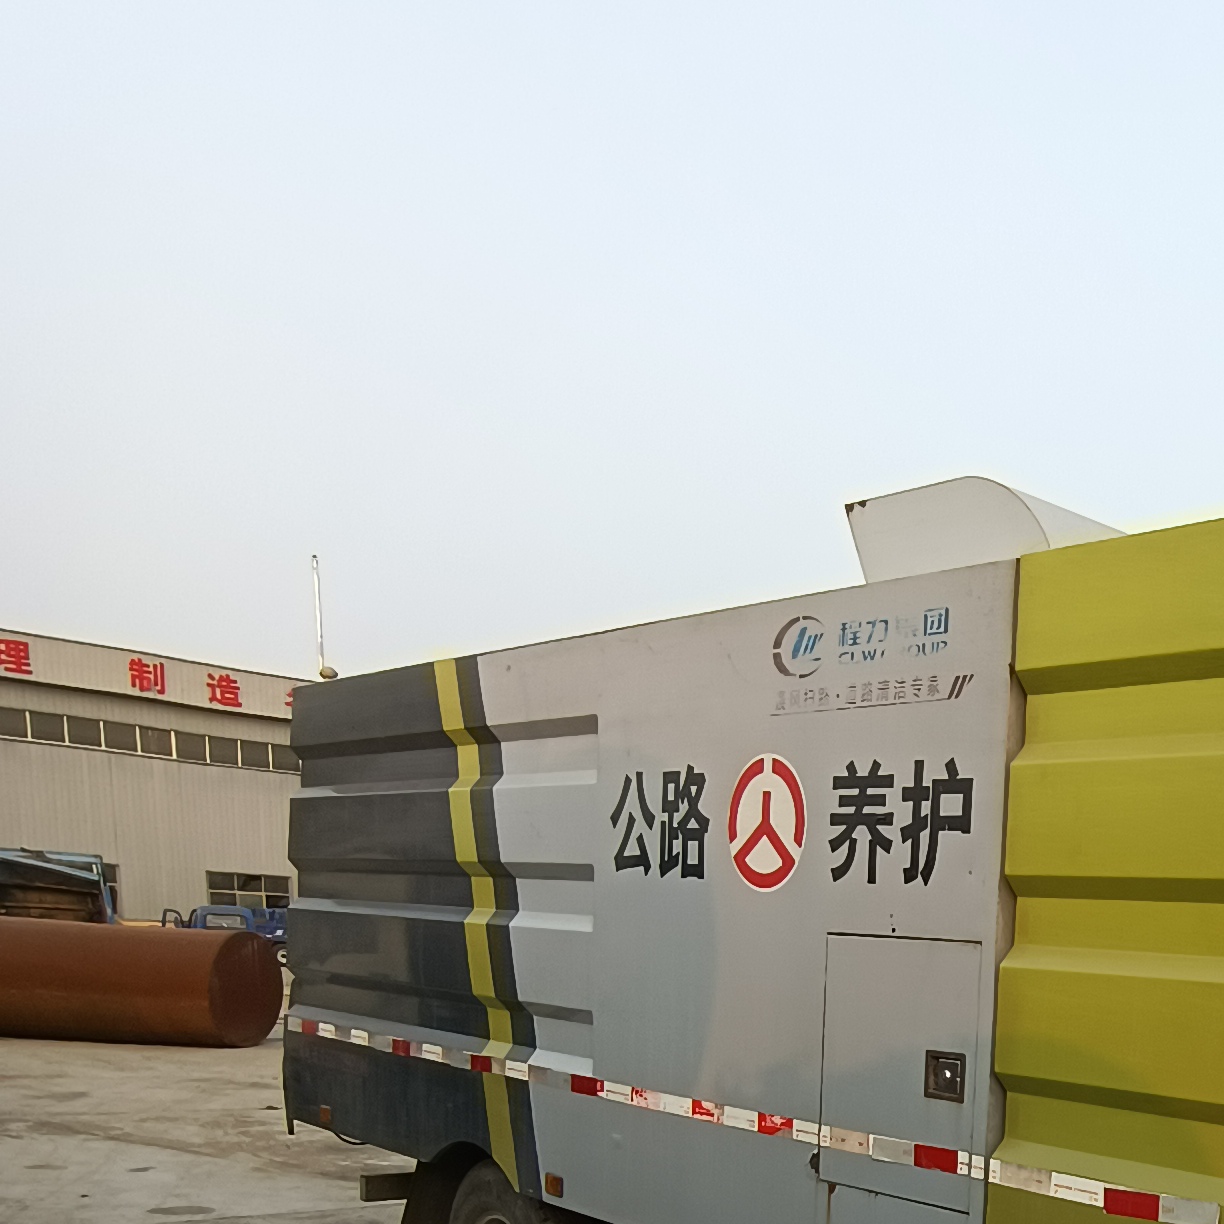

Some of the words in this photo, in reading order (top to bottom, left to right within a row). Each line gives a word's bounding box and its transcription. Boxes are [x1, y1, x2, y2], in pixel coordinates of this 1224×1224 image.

[128, 657, 294, 708] 制造
[609, 763, 711, 881] 公路
[827, 757, 975, 887] 养护
